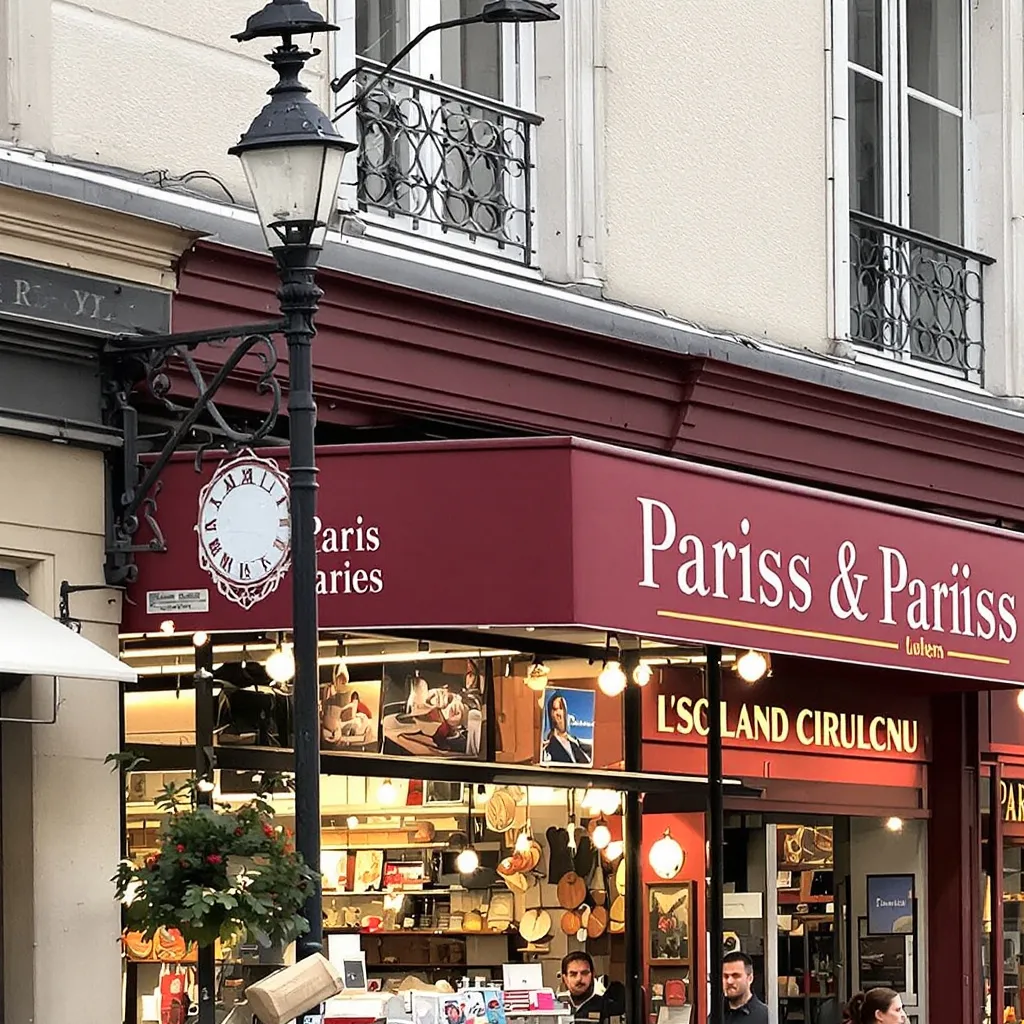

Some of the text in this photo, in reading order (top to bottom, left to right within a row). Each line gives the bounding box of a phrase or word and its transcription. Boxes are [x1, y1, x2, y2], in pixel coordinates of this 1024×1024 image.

[637, 497, 1017, 643] Pariss & Pariiss
